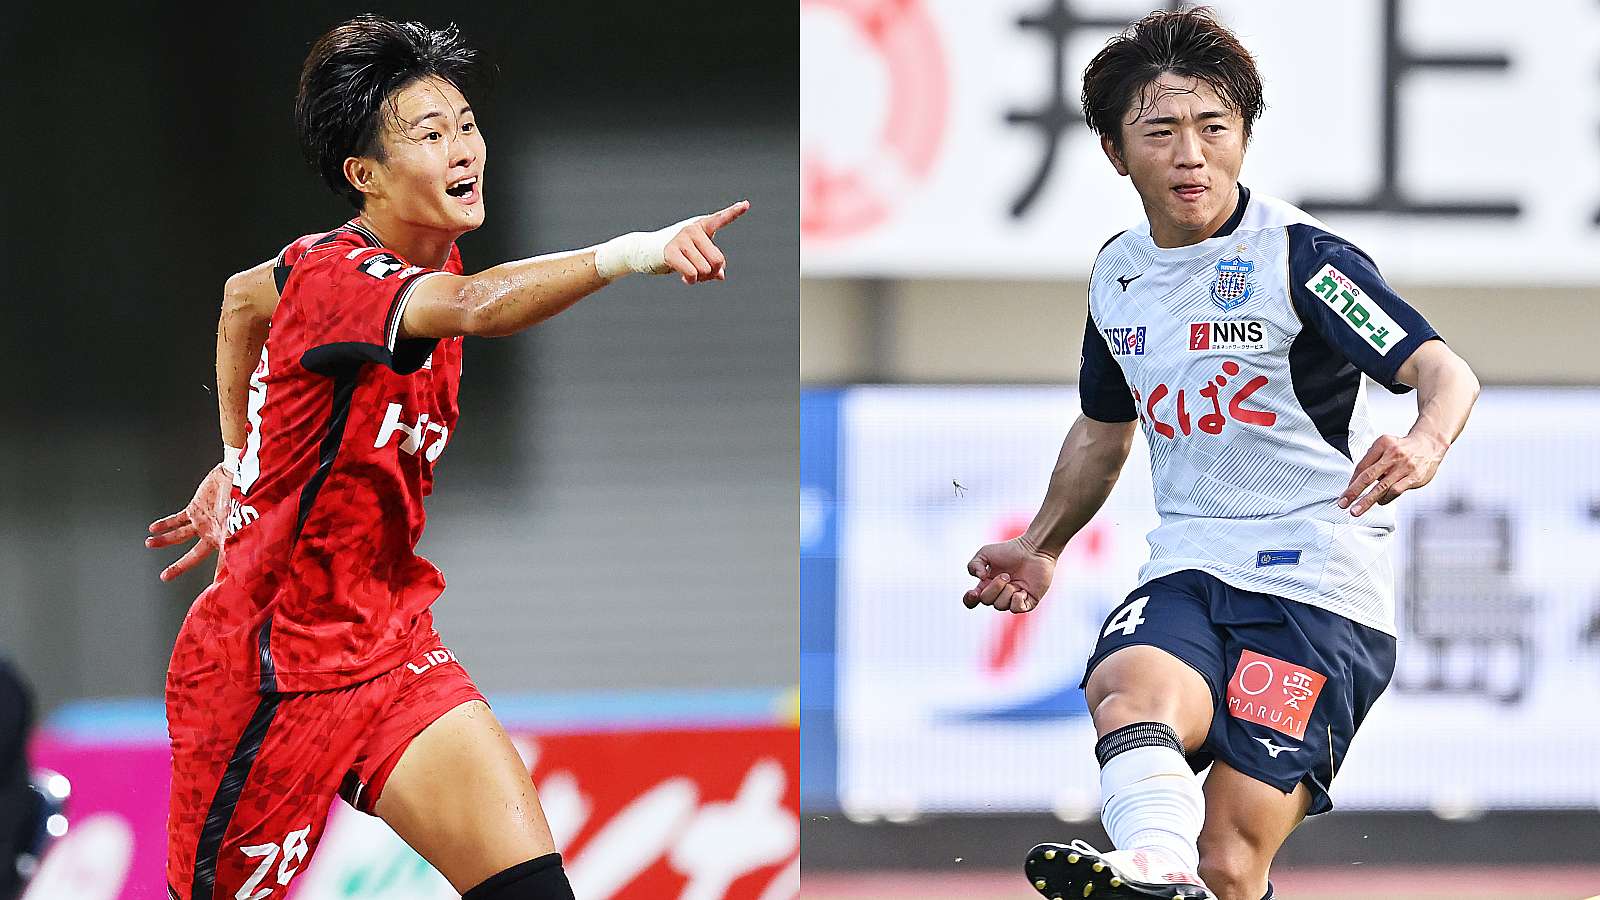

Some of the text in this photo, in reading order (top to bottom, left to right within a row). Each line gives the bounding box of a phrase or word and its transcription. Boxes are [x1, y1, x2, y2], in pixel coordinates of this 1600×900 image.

[1213, 321, 1263, 343] NNS
[1314, 275, 1390, 349] サンロード
[1229, 696, 1302, 734] MARUAI
[235, 823, 311, 900] 28
